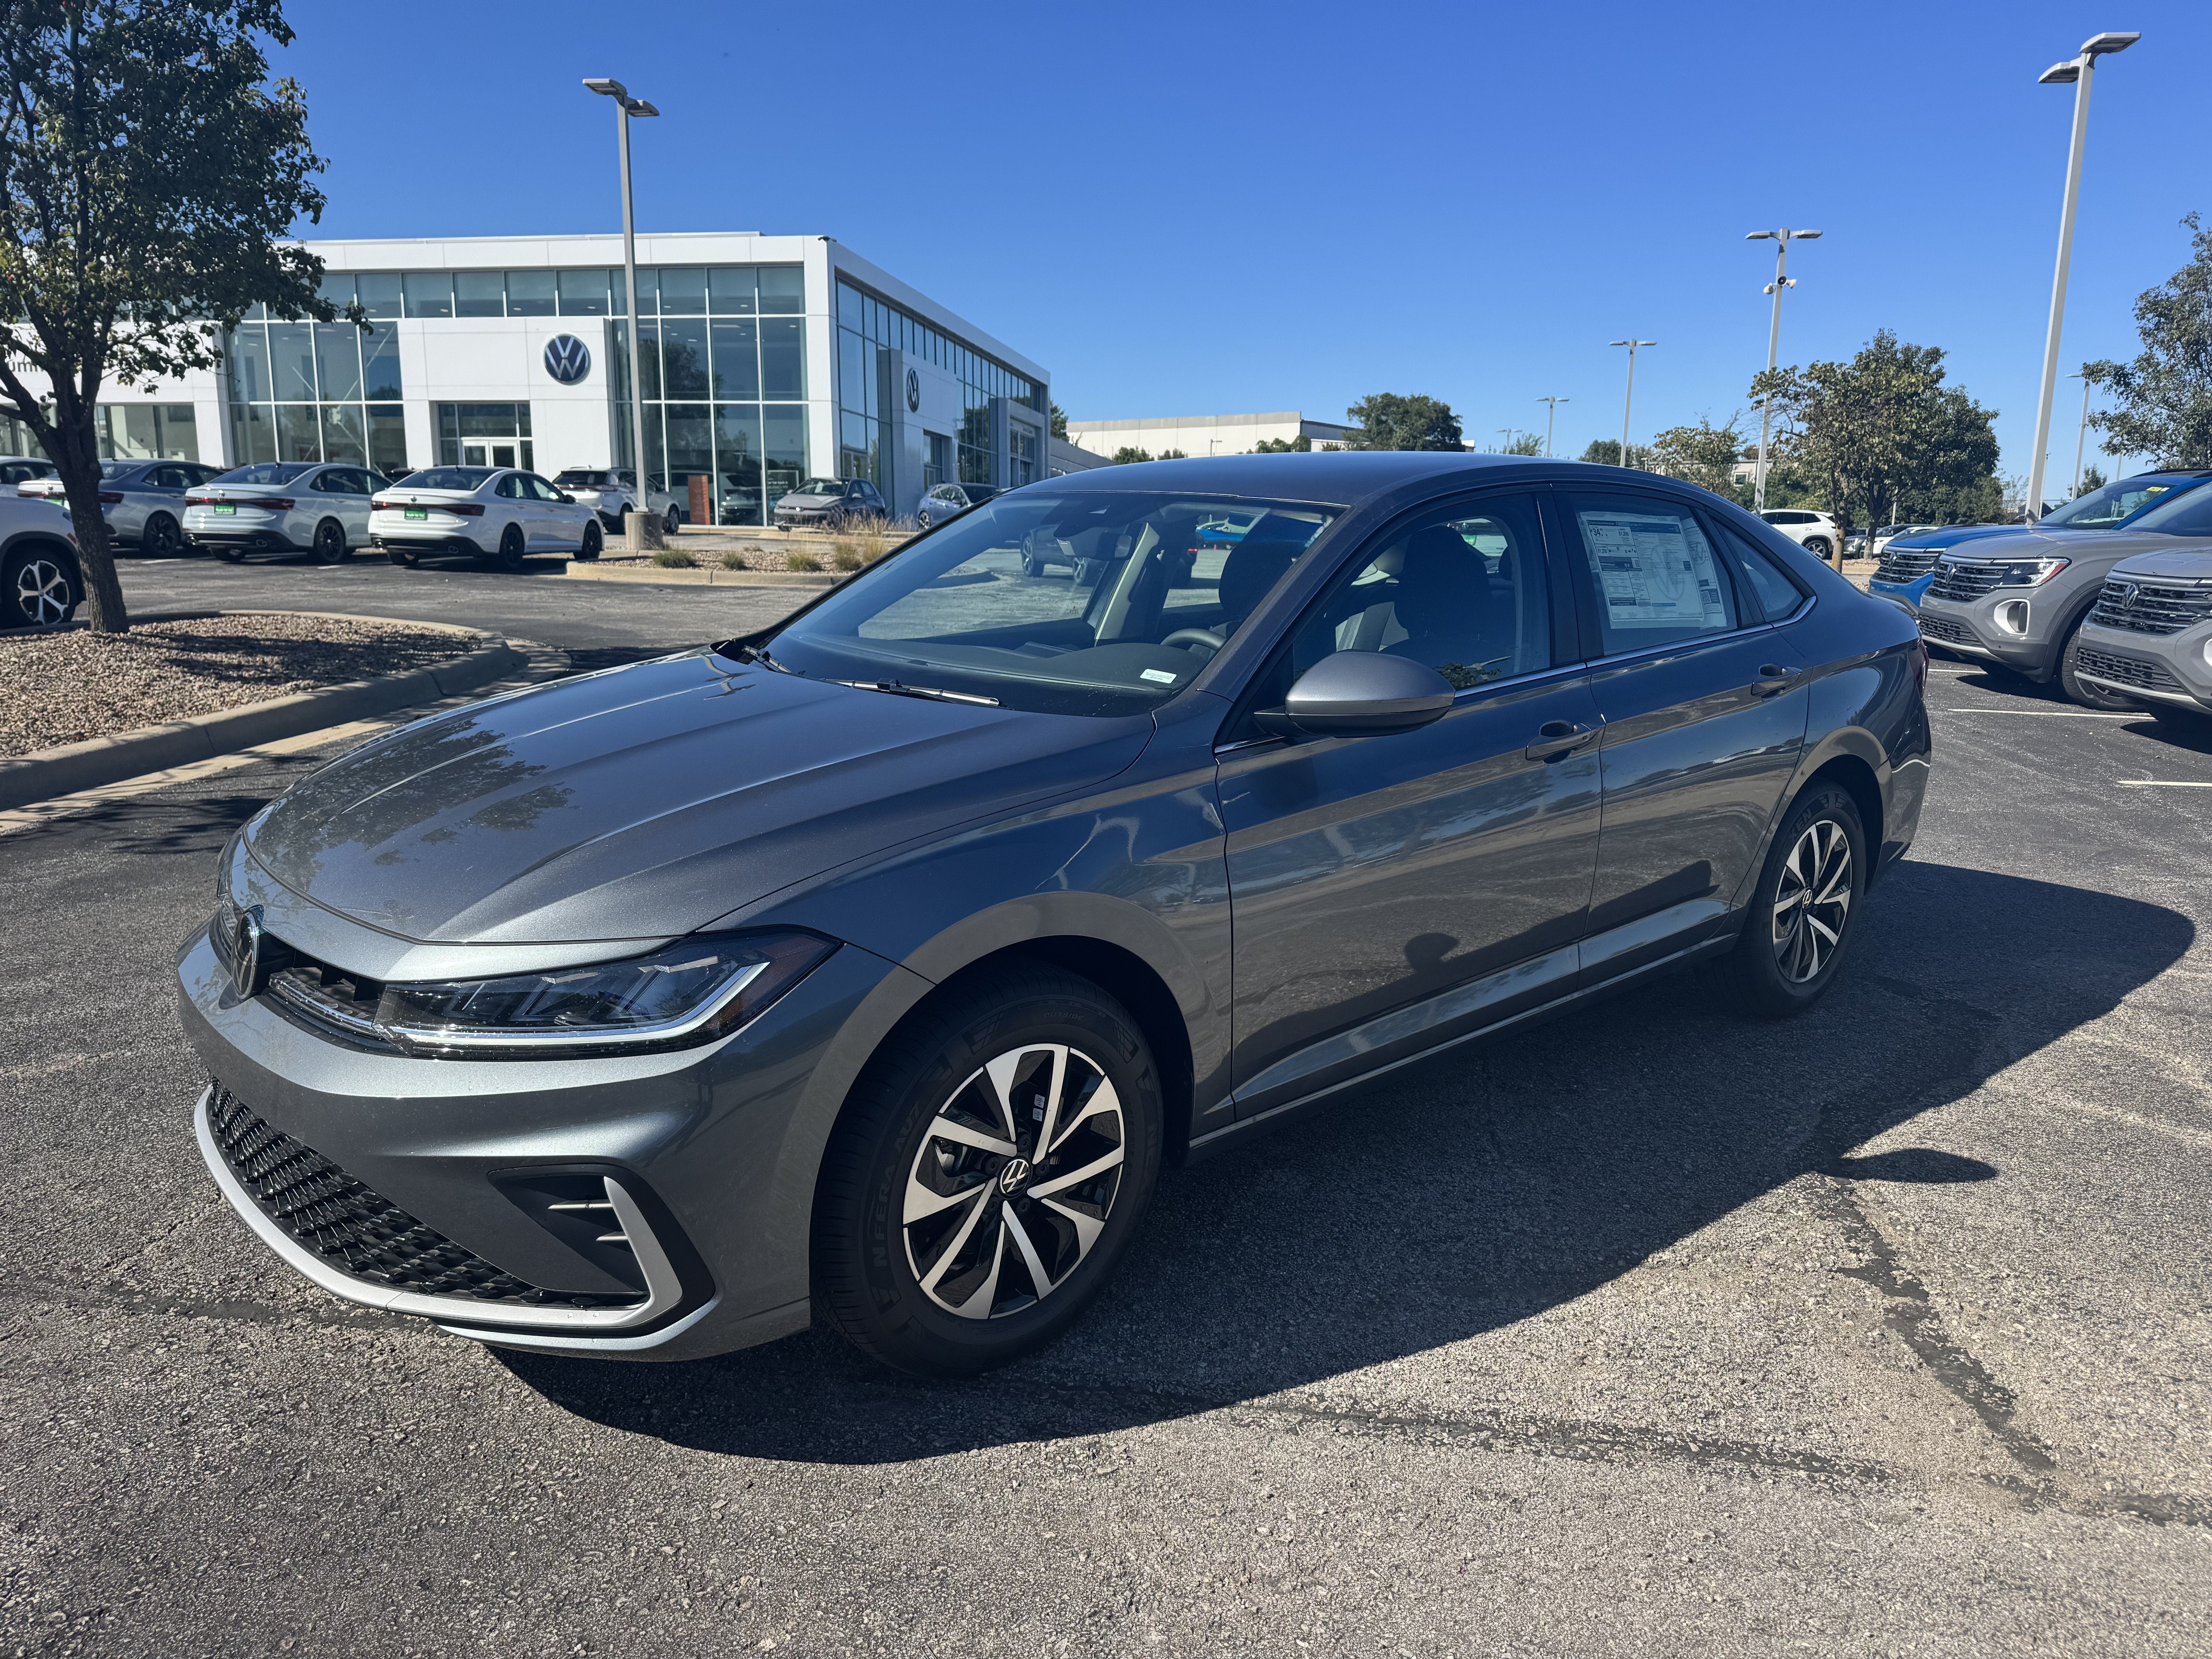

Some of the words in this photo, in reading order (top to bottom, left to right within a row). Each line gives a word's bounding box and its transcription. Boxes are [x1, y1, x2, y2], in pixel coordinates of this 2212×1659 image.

[544, 334, 590, 384] VW
[1042, 1010, 1085, 1022] OUTSIDE
[874, 1163, 896, 1241] FERA
[872, 1246, 887, 1267] N
